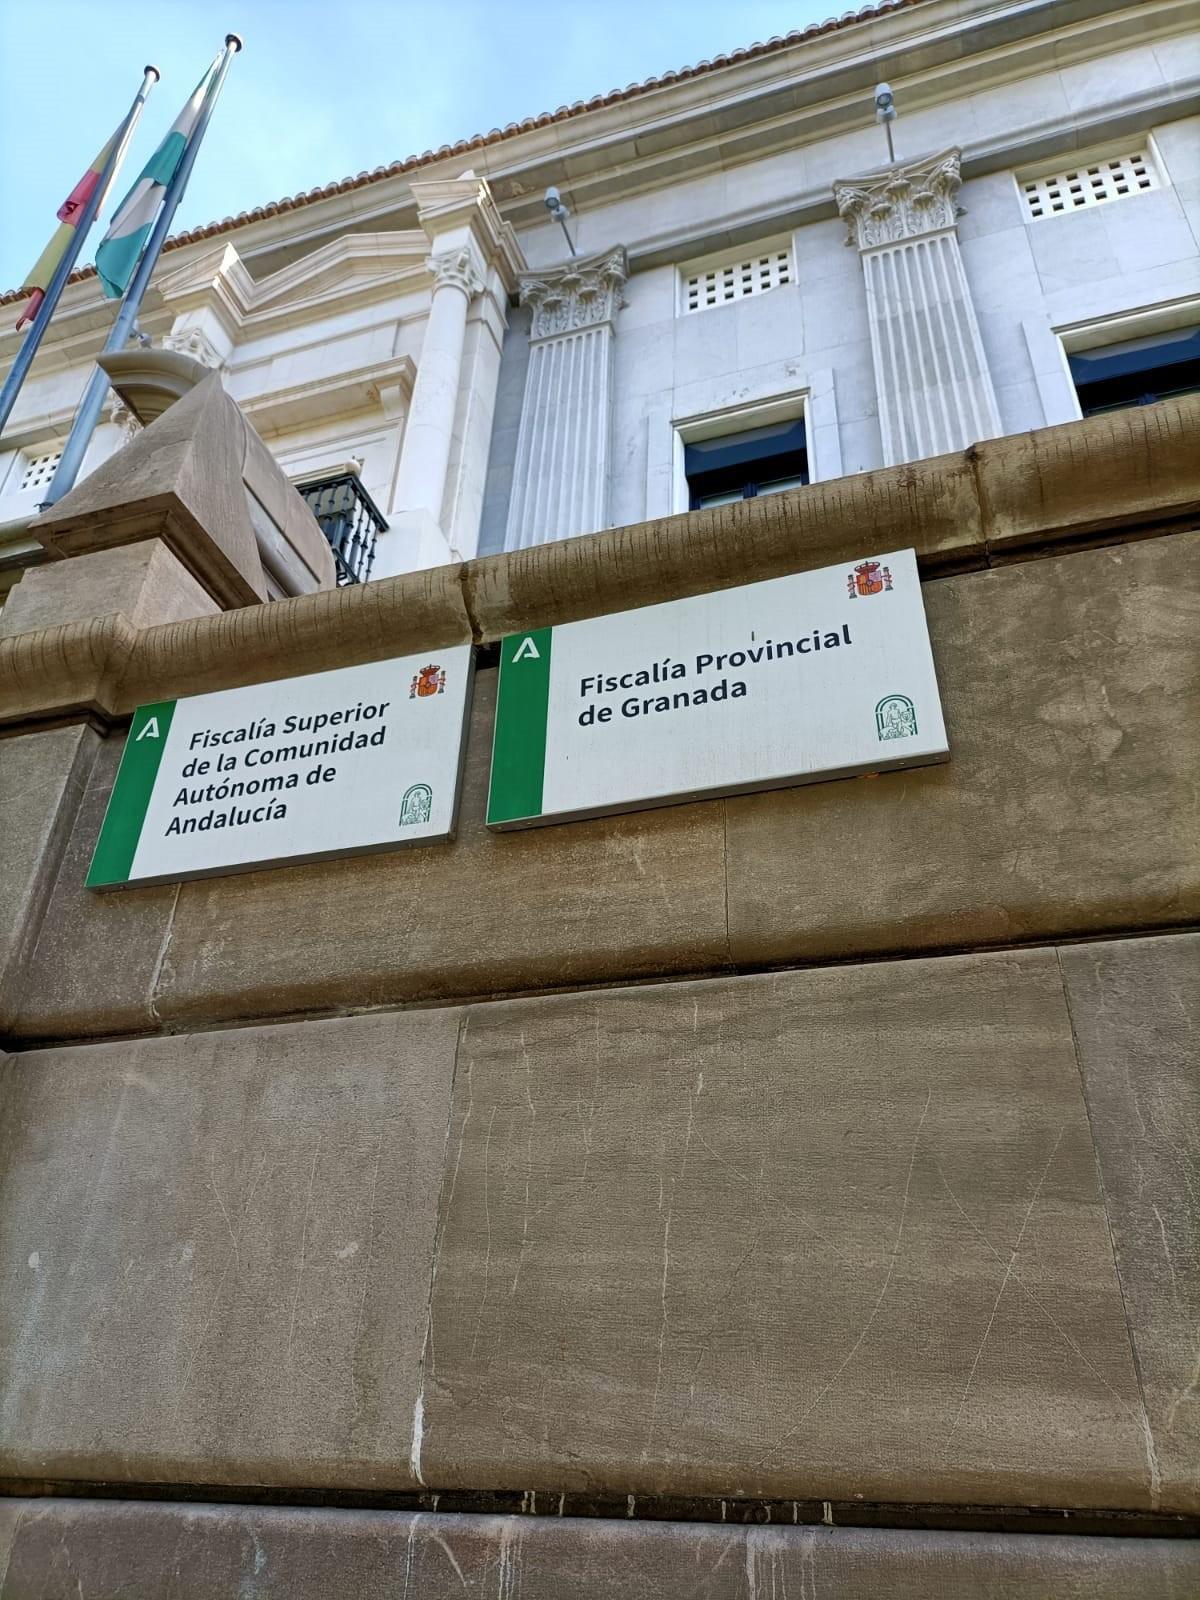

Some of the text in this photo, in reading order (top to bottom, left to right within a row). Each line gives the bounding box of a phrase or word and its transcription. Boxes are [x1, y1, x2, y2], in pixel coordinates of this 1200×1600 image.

[579, 623, 853, 698] Fiscalía Provincial
[188, 700, 391, 751] Fiscalía Superior
[577, 677, 748, 727] de Granada
[181, 725, 387, 779] de la Comunidad
[172, 763, 337, 808] Autónoma de
[164, 797, 288, 838] Andalucía
